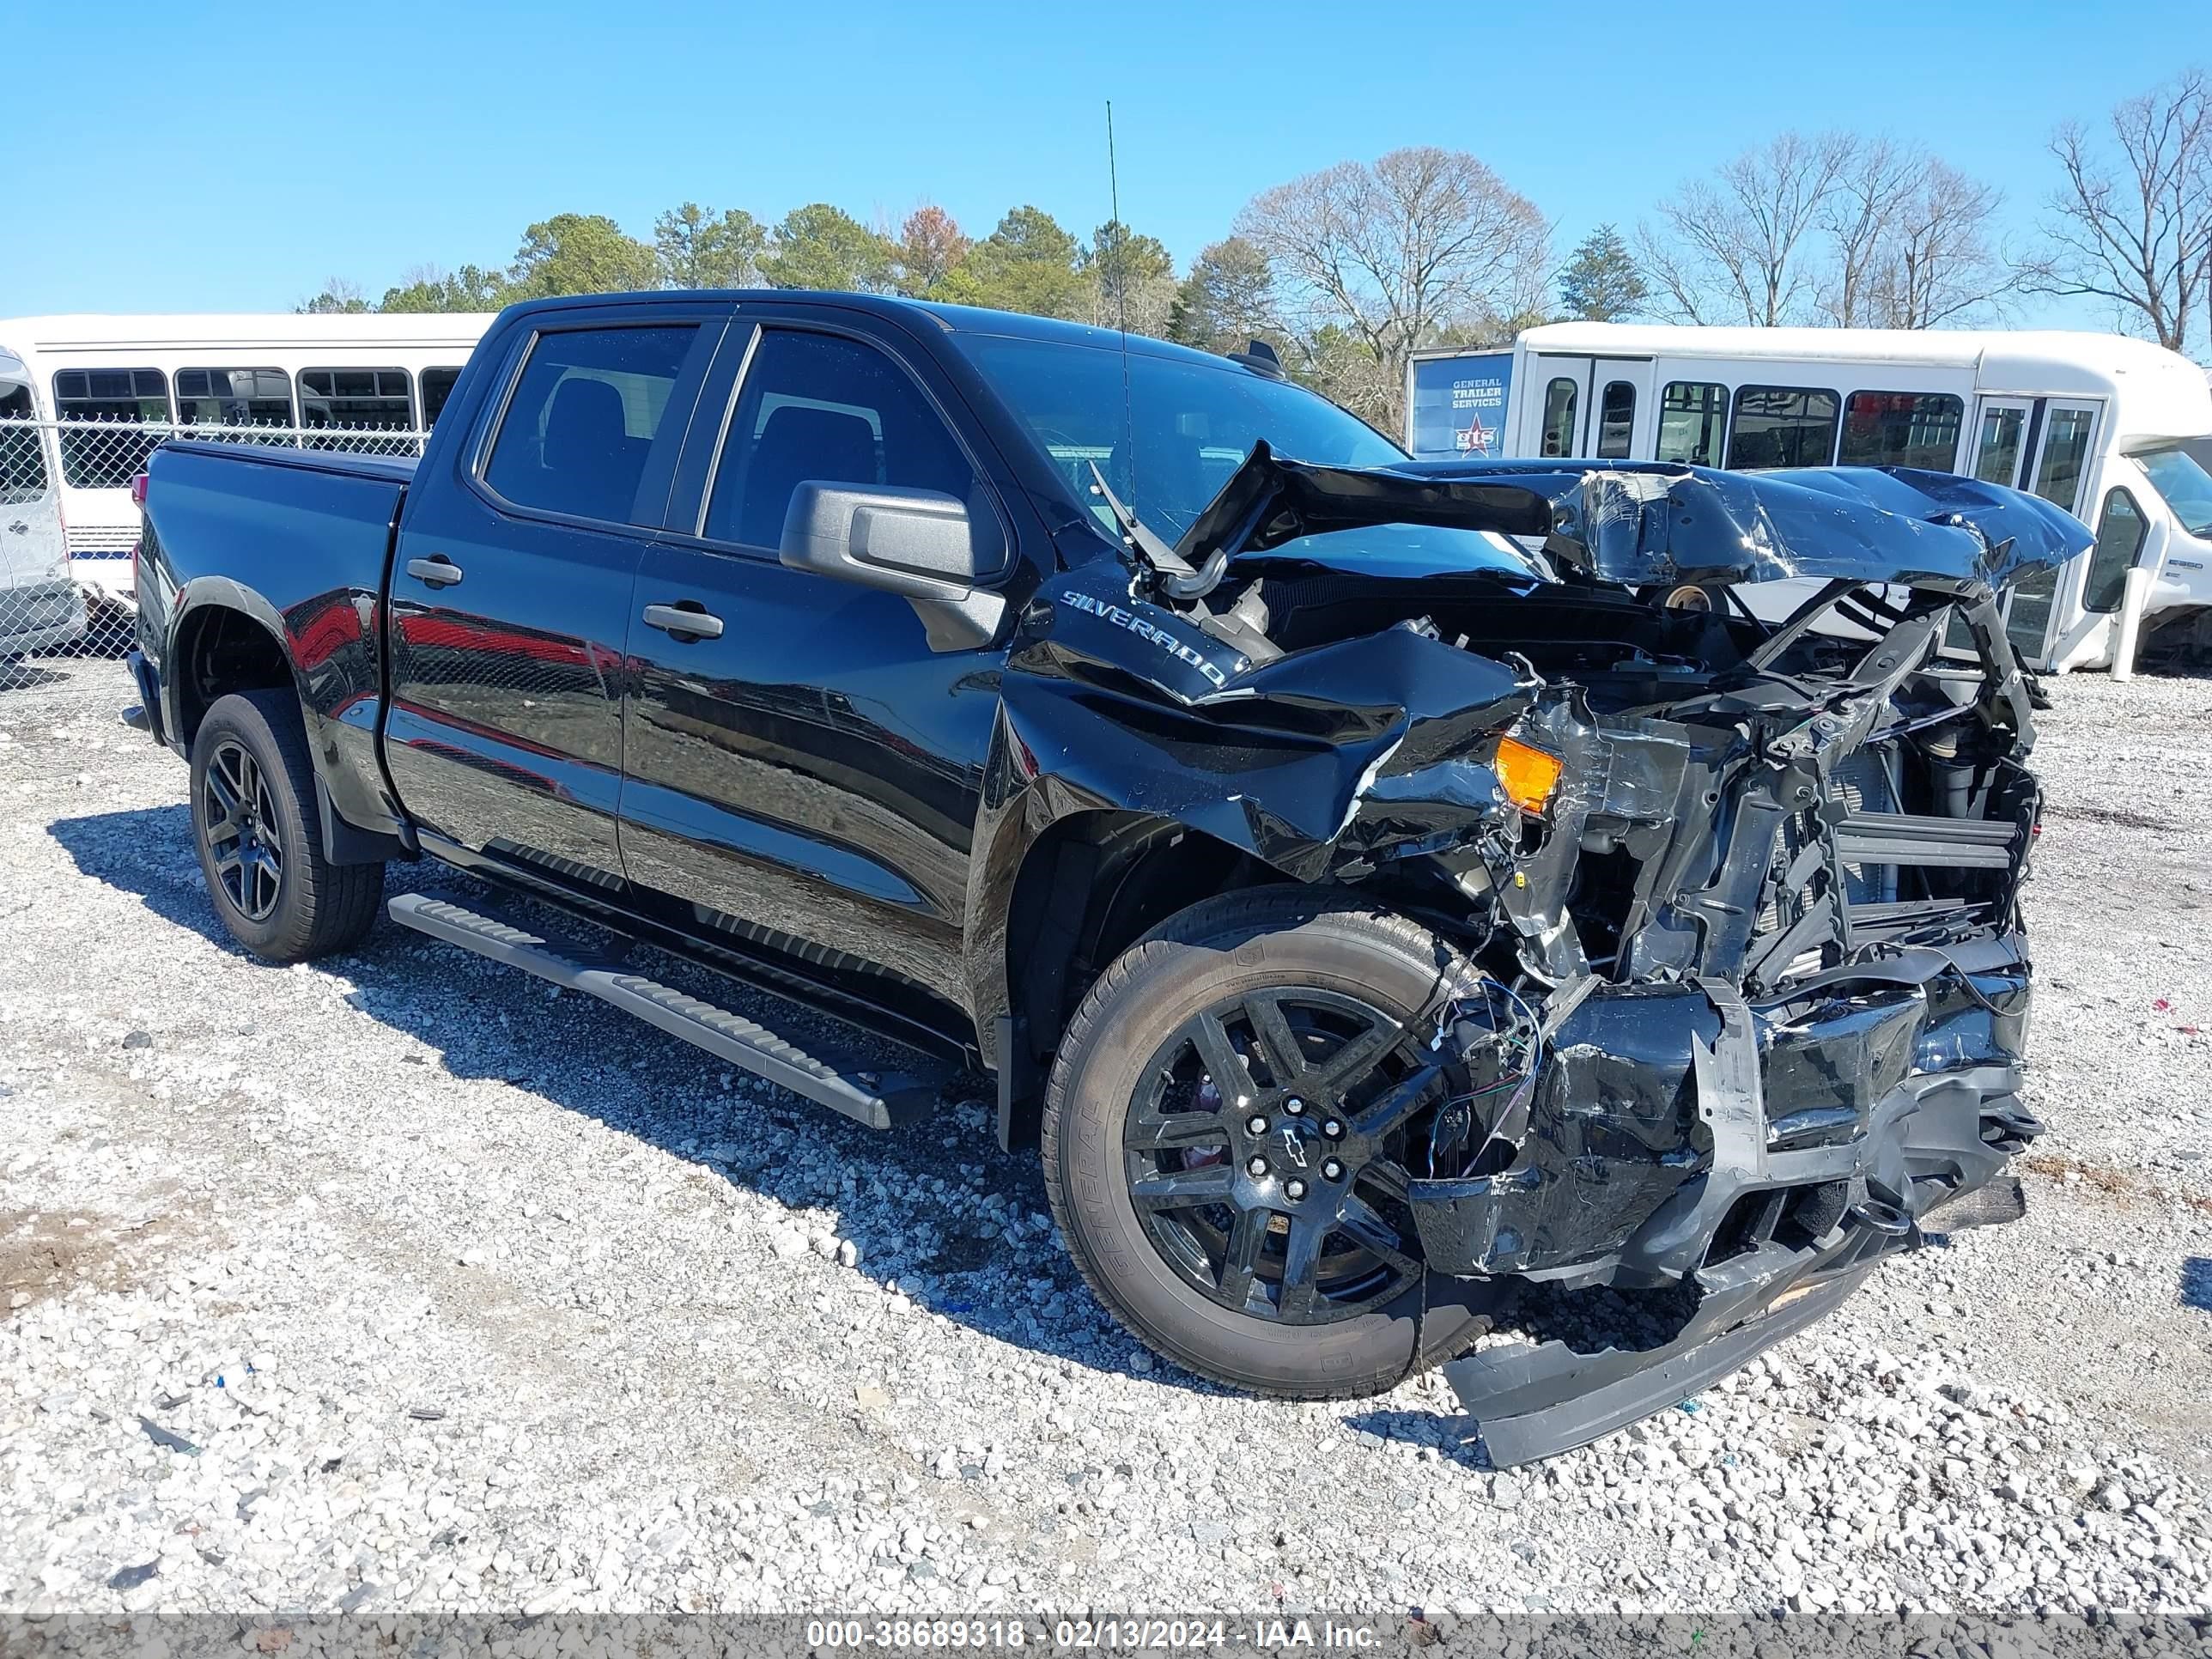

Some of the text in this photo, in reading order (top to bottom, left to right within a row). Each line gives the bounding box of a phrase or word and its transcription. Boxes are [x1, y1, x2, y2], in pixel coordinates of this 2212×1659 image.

[1453, 378, 1502, 389] GENERAL
[1453, 387, 1502, 398] TRAILER
[1452, 398, 1502, 409] SERVICES
[1456, 429, 1494, 450] gts
[1060, 590, 1226, 686] SILVERADO
